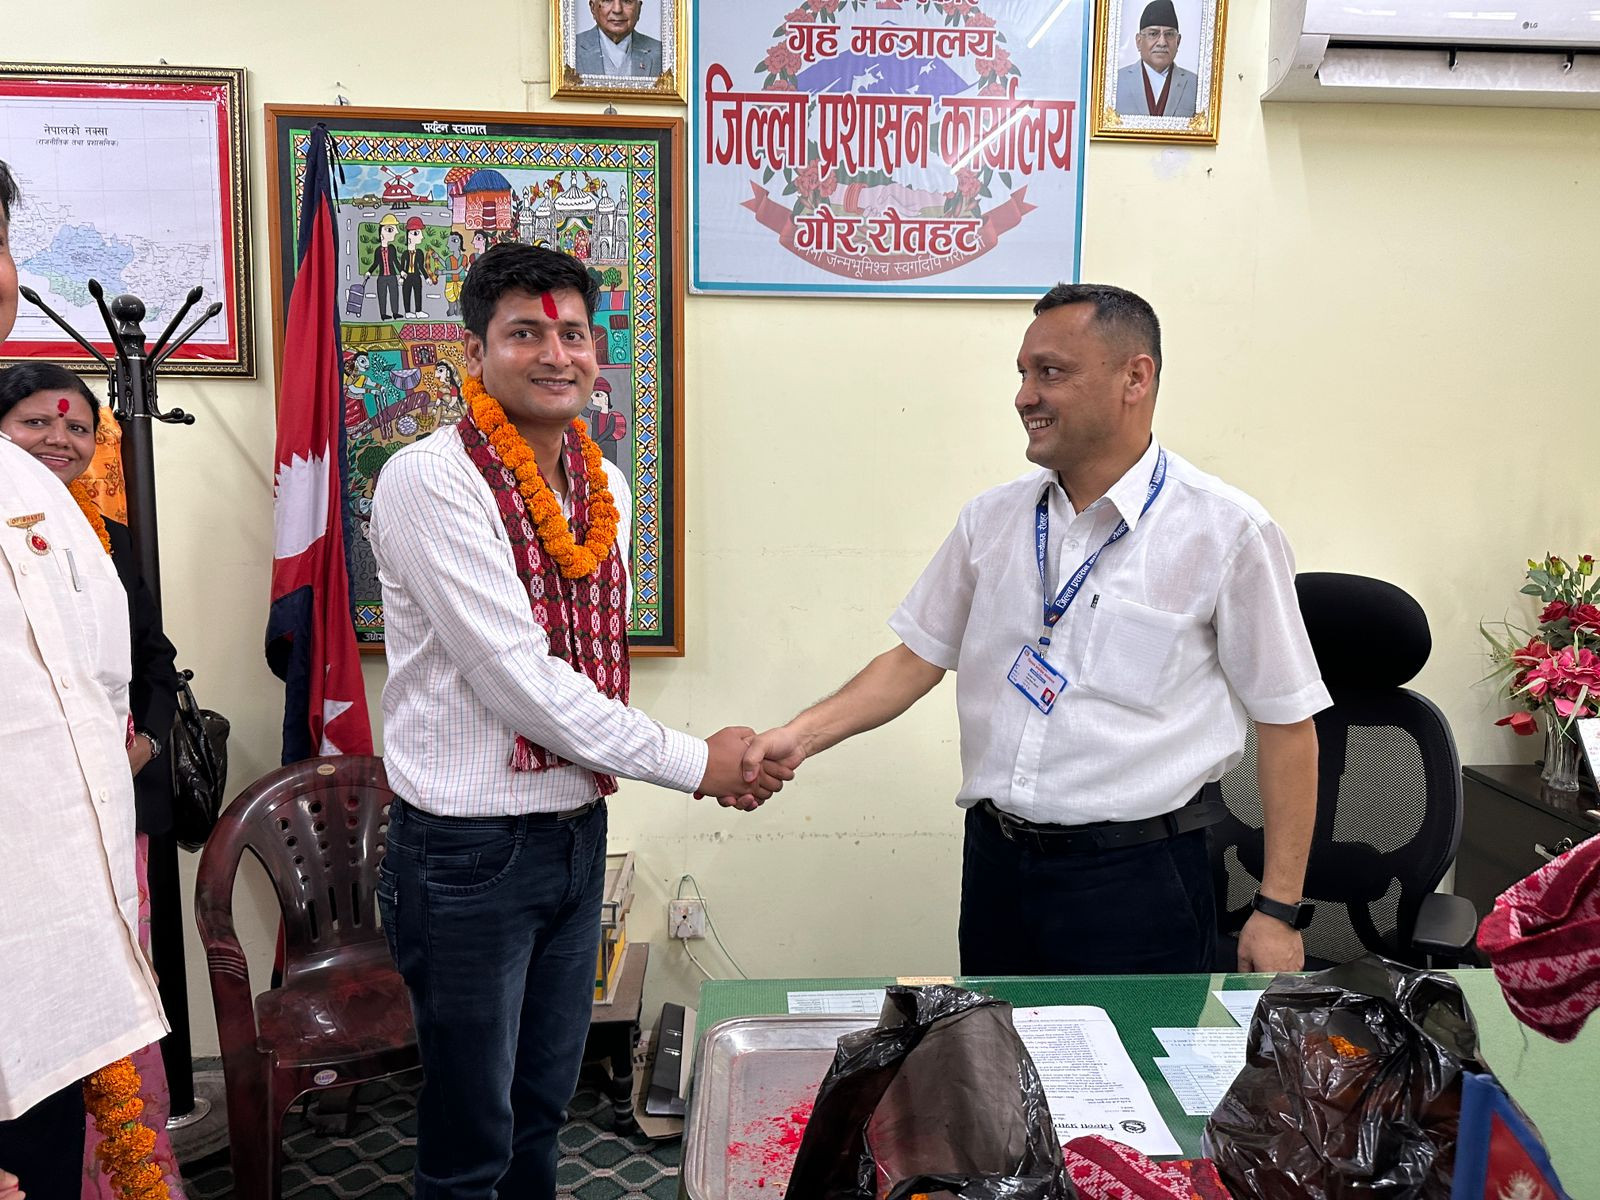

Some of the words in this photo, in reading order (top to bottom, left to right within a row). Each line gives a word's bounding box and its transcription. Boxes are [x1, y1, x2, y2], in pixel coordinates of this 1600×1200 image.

[788, 25, 841, 62] गृह
[851, 26, 997, 58] मन्त्रालय
[44, 123, 80, 135] नेपालको
[85, 126, 108, 136] नक्सा
[452, 124, 487, 135] स्वागत
[705, 63, 809, 171] जिल्ला
[818, 94, 932, 177] प्रशासन
[942, 77, 1076, 171] कार्यालय
[1055, 586, 1075, 609] जिल्ला
